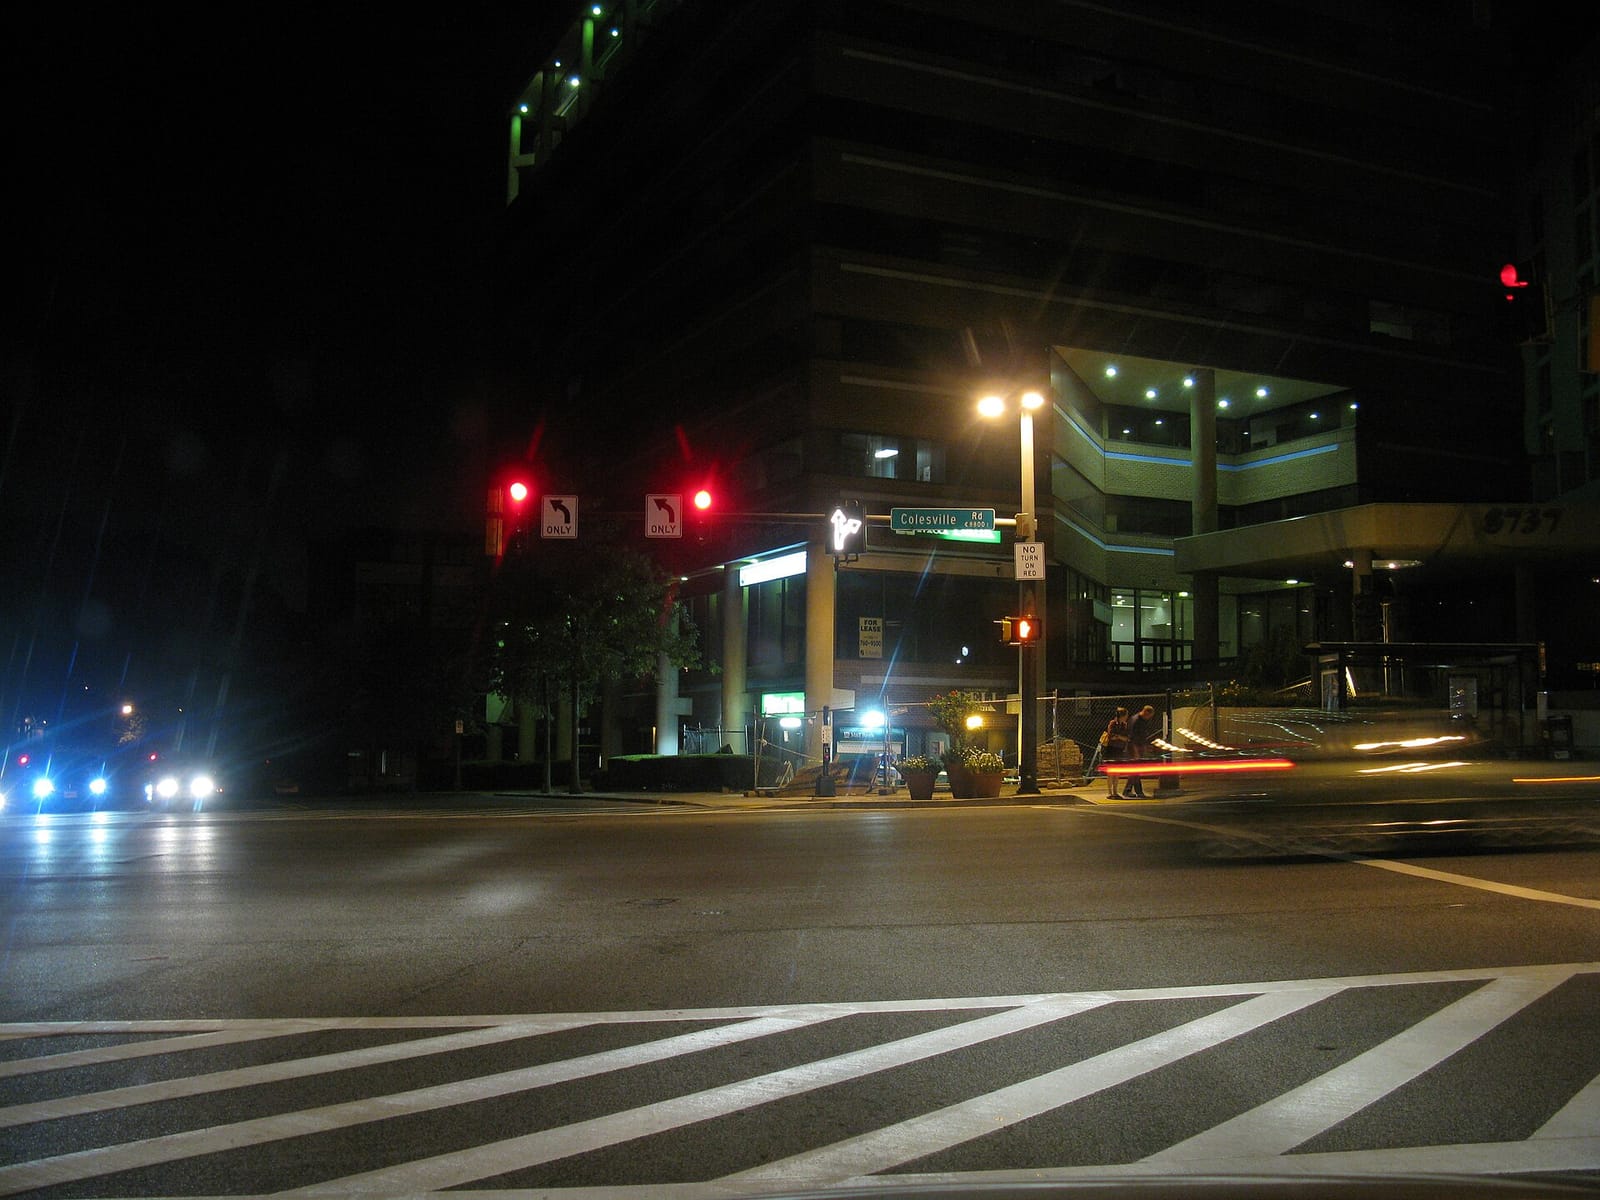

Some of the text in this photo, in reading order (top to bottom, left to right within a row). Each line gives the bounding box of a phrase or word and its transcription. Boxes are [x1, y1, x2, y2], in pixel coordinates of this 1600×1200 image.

[900, 511, 983, 526] Colesville Rd
[546, 525, 572, 535] ONLY
[651, 524, 677, 534] ONLY
[1022, 546, 1036, 554] NO
[860, 625, 881, 633] LEASE
